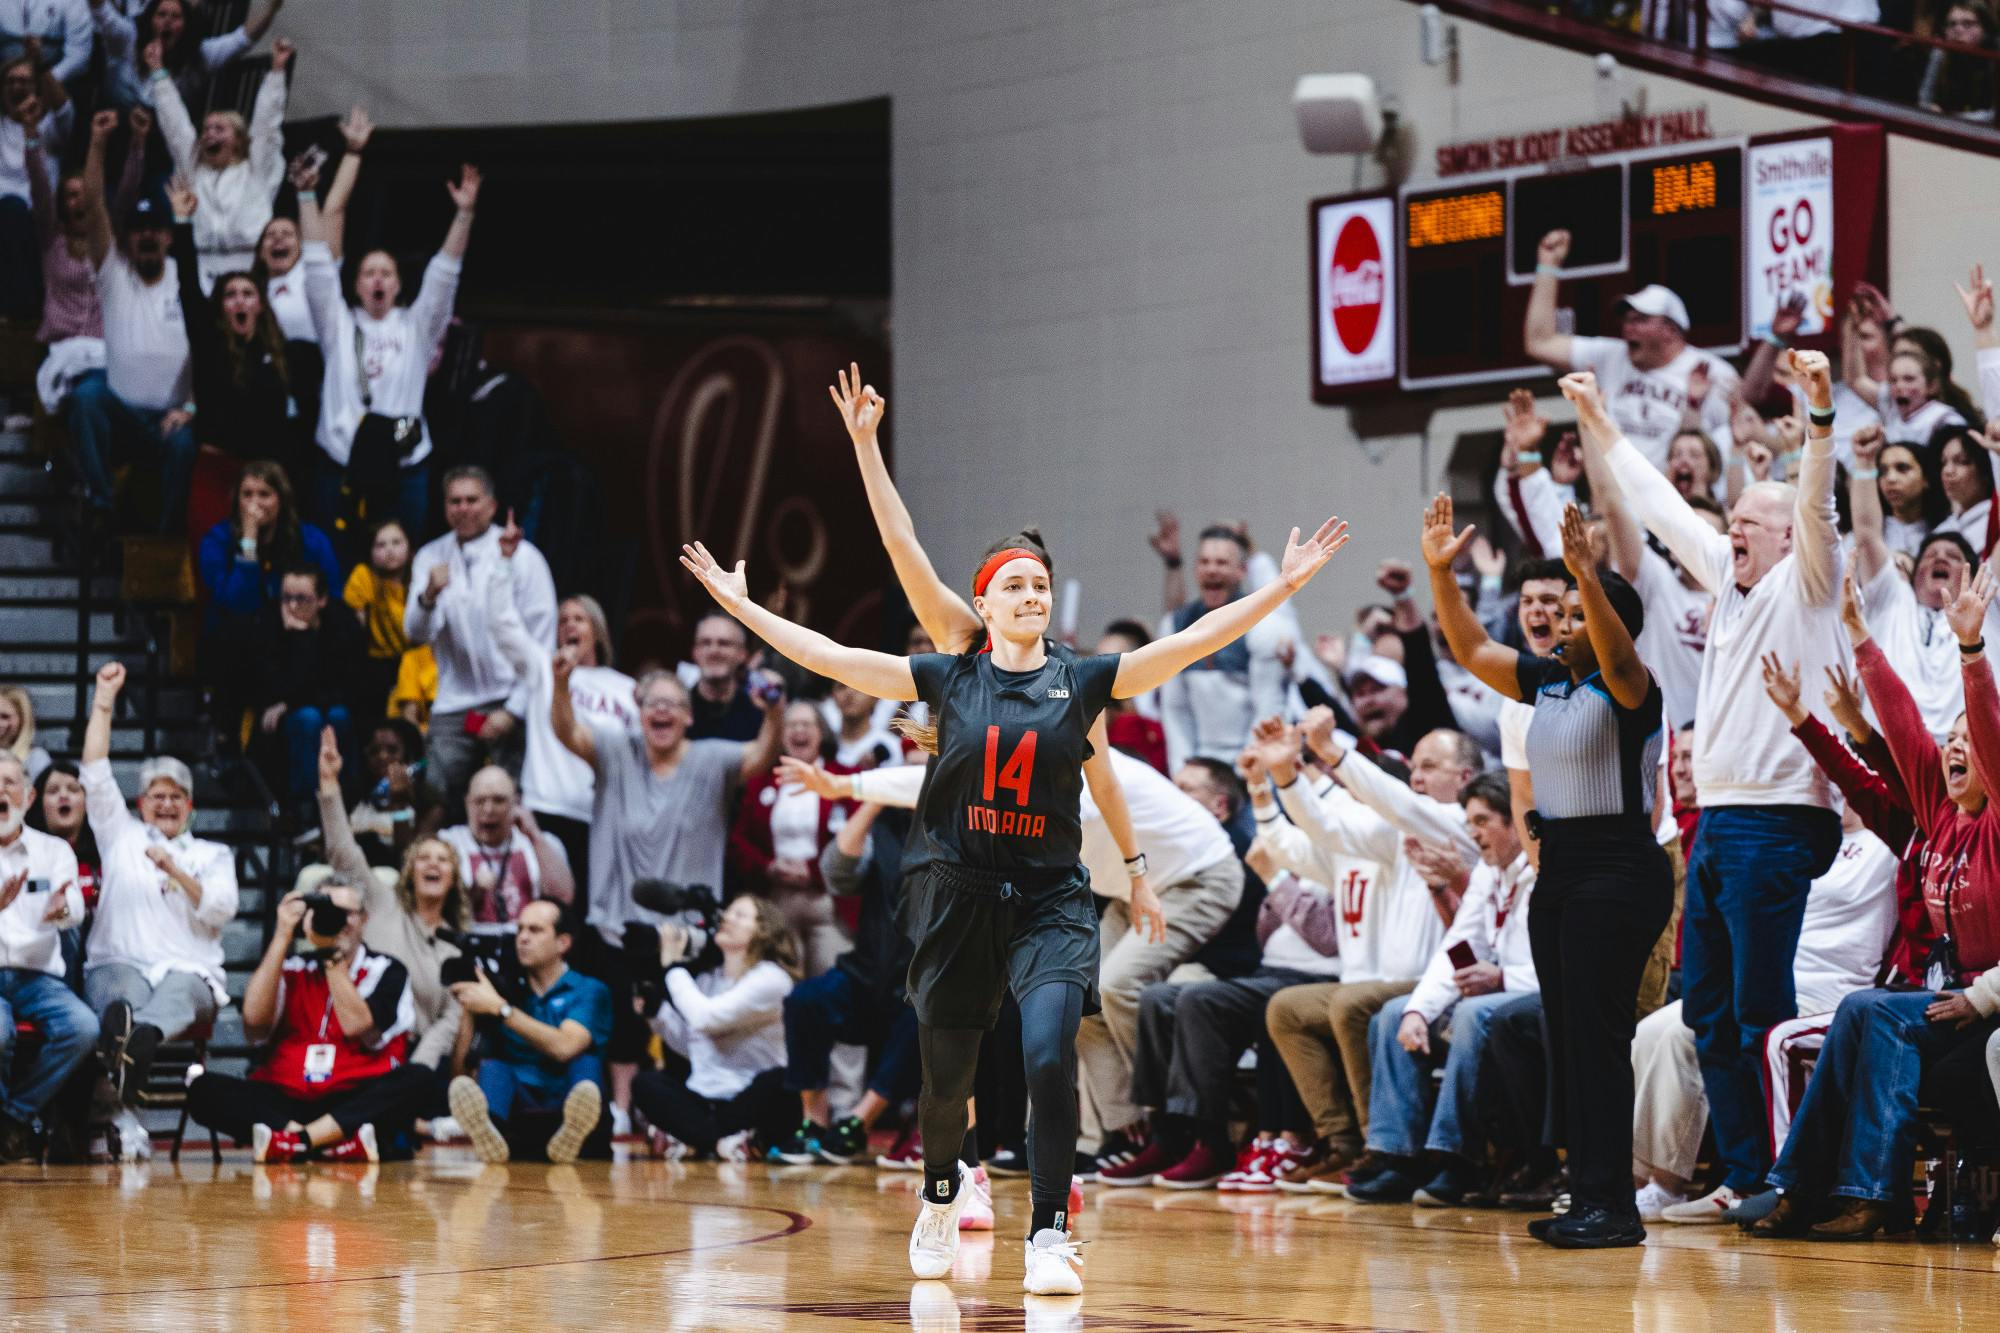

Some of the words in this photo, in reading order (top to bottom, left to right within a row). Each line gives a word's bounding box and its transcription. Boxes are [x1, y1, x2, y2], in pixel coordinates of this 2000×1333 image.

[1436, 140, 1493, 178] SIMON
[1565, 114, 1656, 156] ASSEMBLY
[1659, 104, 1715, 145] HALL
[1756, 151, 1832, 186] Smithville
[1769, 197, 1815, 255] GO
[1763, 250, 1825, 296] TEAM!
[983, 725, 1038, 807] 14
[968, 805, 1046, 839] INDIANA
